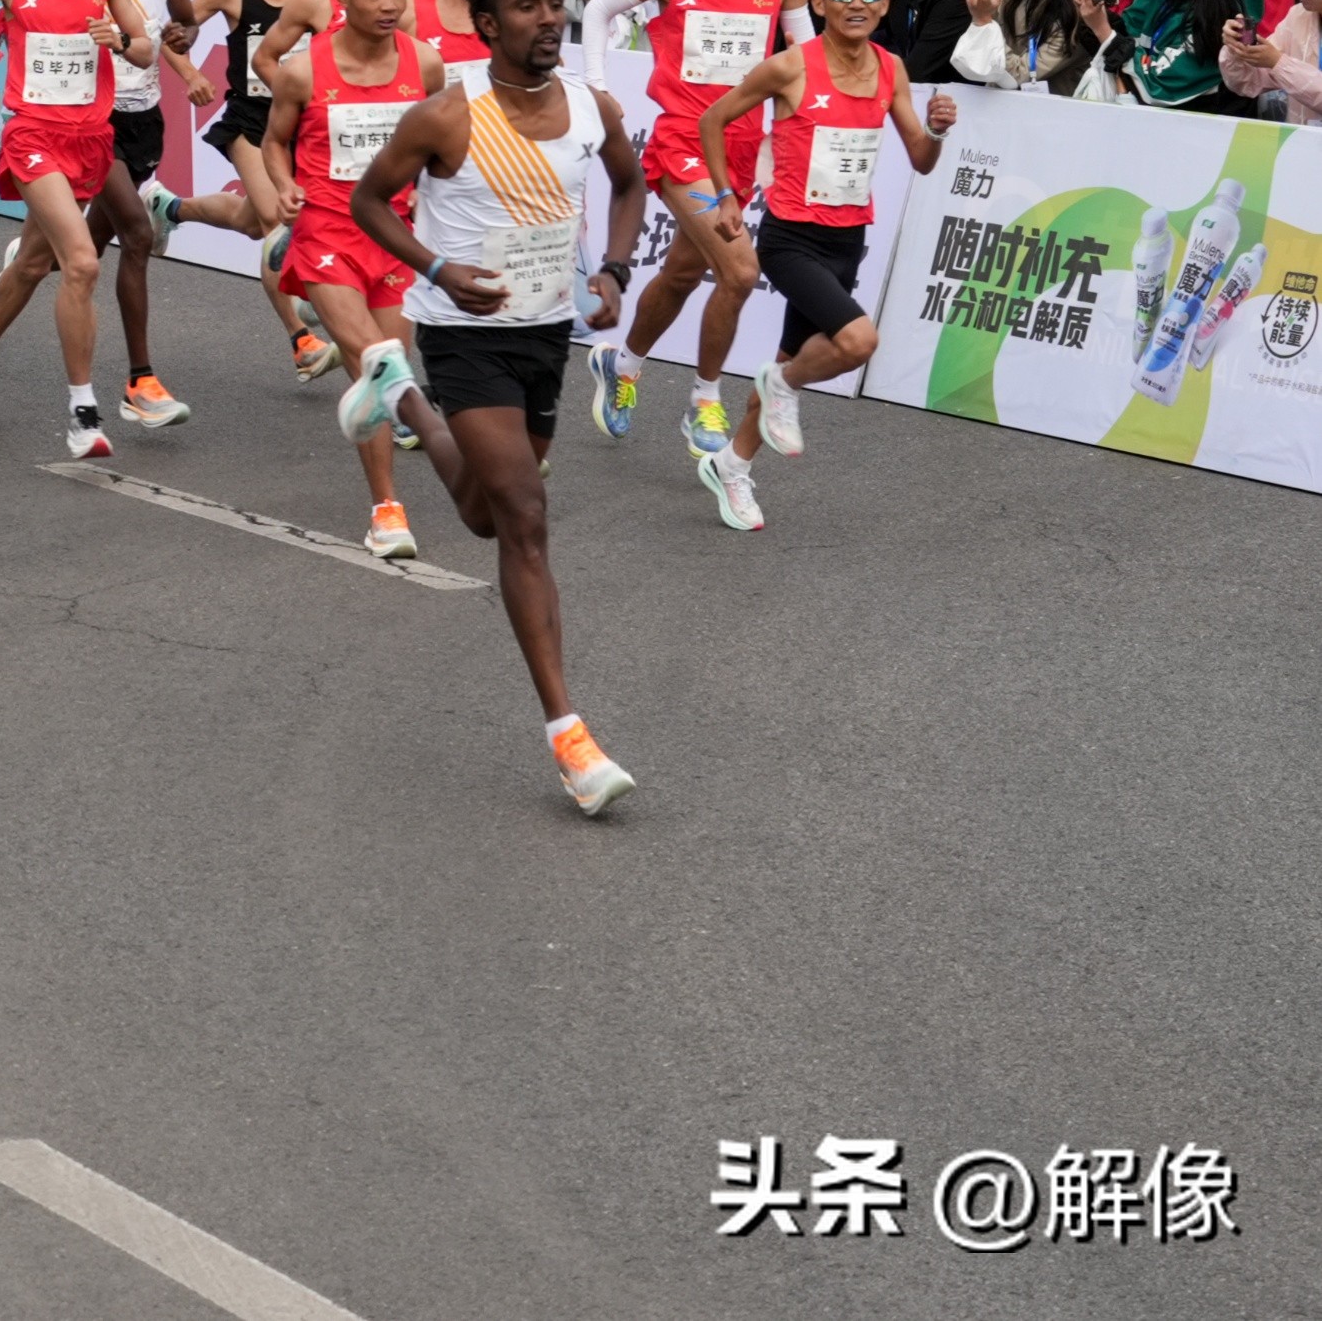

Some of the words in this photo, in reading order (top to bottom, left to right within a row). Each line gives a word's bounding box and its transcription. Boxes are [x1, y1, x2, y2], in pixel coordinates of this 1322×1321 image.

[701, 38, 751, 56] 高成亮
[32, 59, 94, 75] 包毕力格
[59, 80, 68, 88] 10
[959, 147, 1000, 167] Mulene
[950, 165, 995, 200] 魔力
[503, 254, 536, 270] ABEBE
[929, 214, 1111, 304] 随时补充
[1191, 237, 1226, 262] Mulene
[531, 281, 542, 293] 22
[1176, 262, 1216, 300] 魔力
[919, 281, 1093, 350] 水分和电解质
[1275, 295, 1312, 323] 持续
[1269, 320, 1305, 348] 能量
